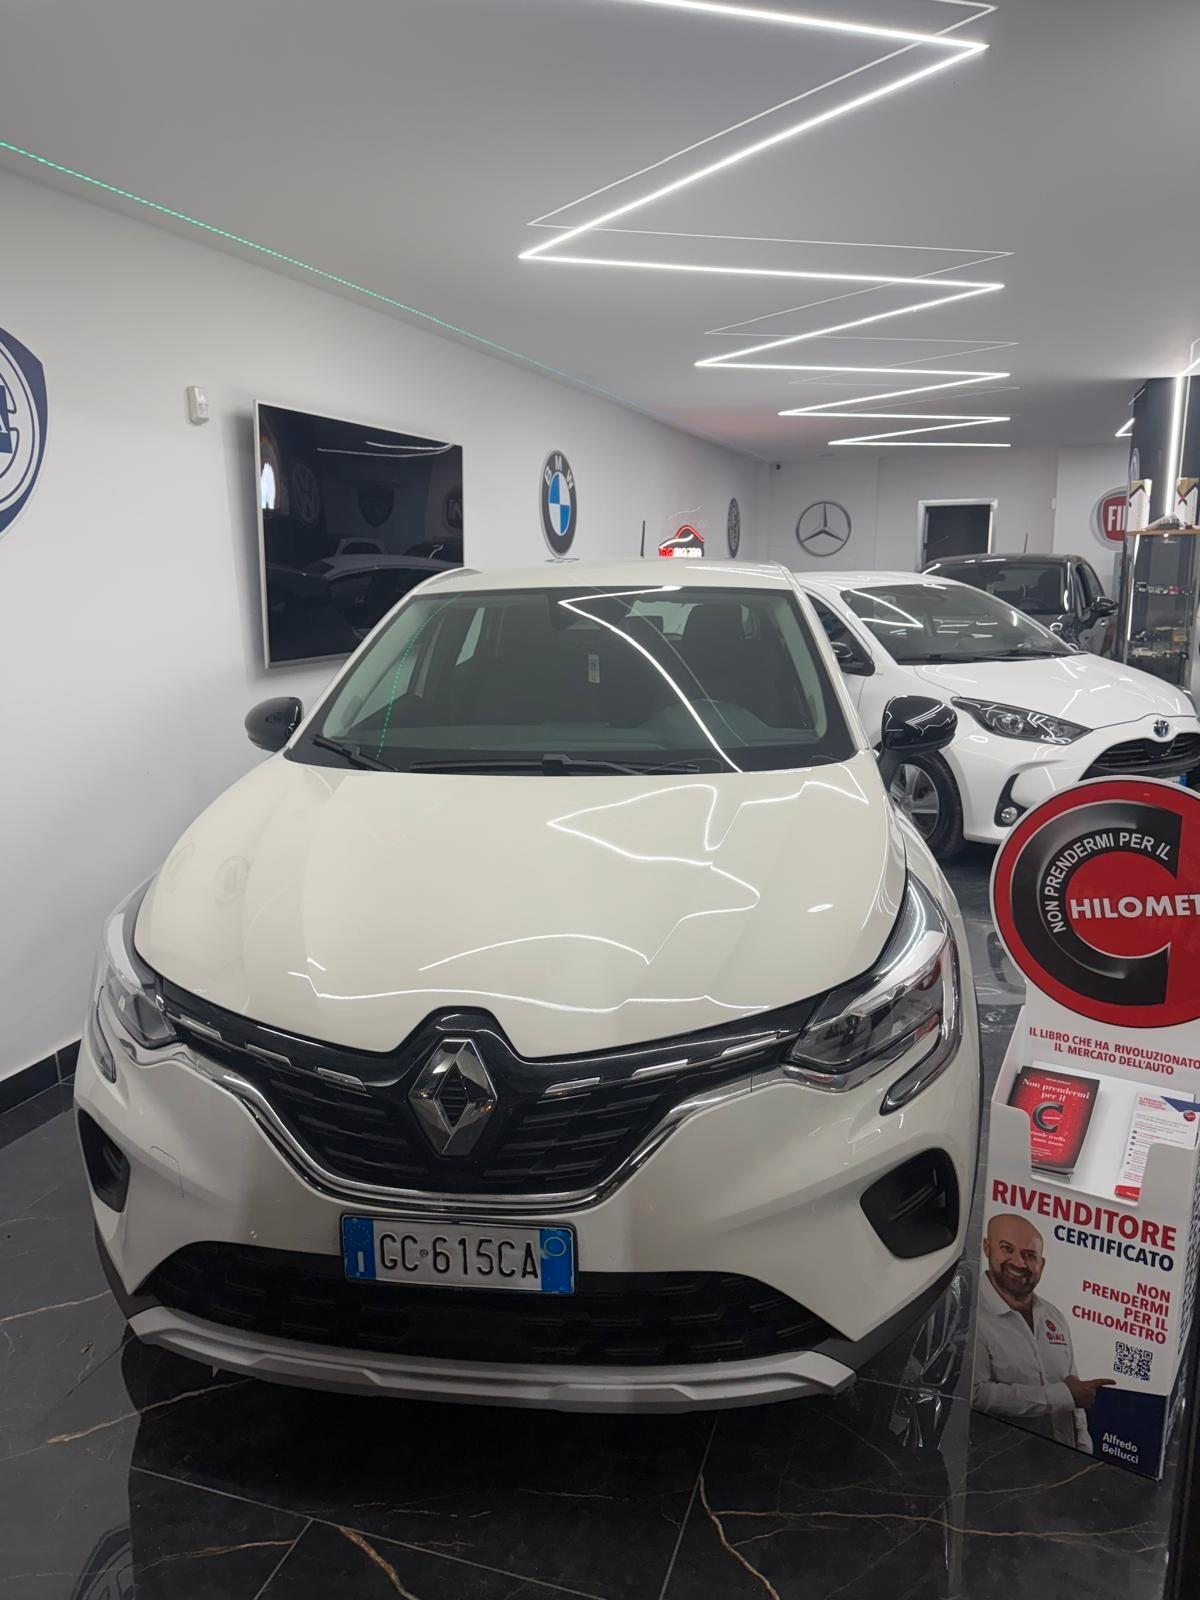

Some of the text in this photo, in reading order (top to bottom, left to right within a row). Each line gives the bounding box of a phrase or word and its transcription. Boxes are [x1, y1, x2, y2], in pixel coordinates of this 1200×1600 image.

[544, 455, 574, 489] BMW
[1044, 832, 1171, 934] NON PRENDERMI PER IL
[1029, 1026, 1200, 1070] IL LIBRO CHE HA RIVOLUZIONATO
[1054, 1043, 1174, 1075] IL MERCATO DELL'AUTO
[1022, 1078, 1041, 1088] Non
[1042, 1084, 1091, 1100] prendermi
[1041, 1092, 1066, 1102] per il
[992, 1179, 1177, 1251] RIVENDITORE
[1053, 1224, 1174, 1272] CERTIFICATO
[1082, 1280, 1169, 1317] PRENDERMI
[1136, 1282, 1171, 1301] NON
[1072, 1305, 1167, 1345] CHILOMETRO
[1123, 1306, 1168, 1332] PER IL
[1102, 1432, 1138, 1453] Alfredo
[1102, 1443, 1139, 1464] Bellucci
